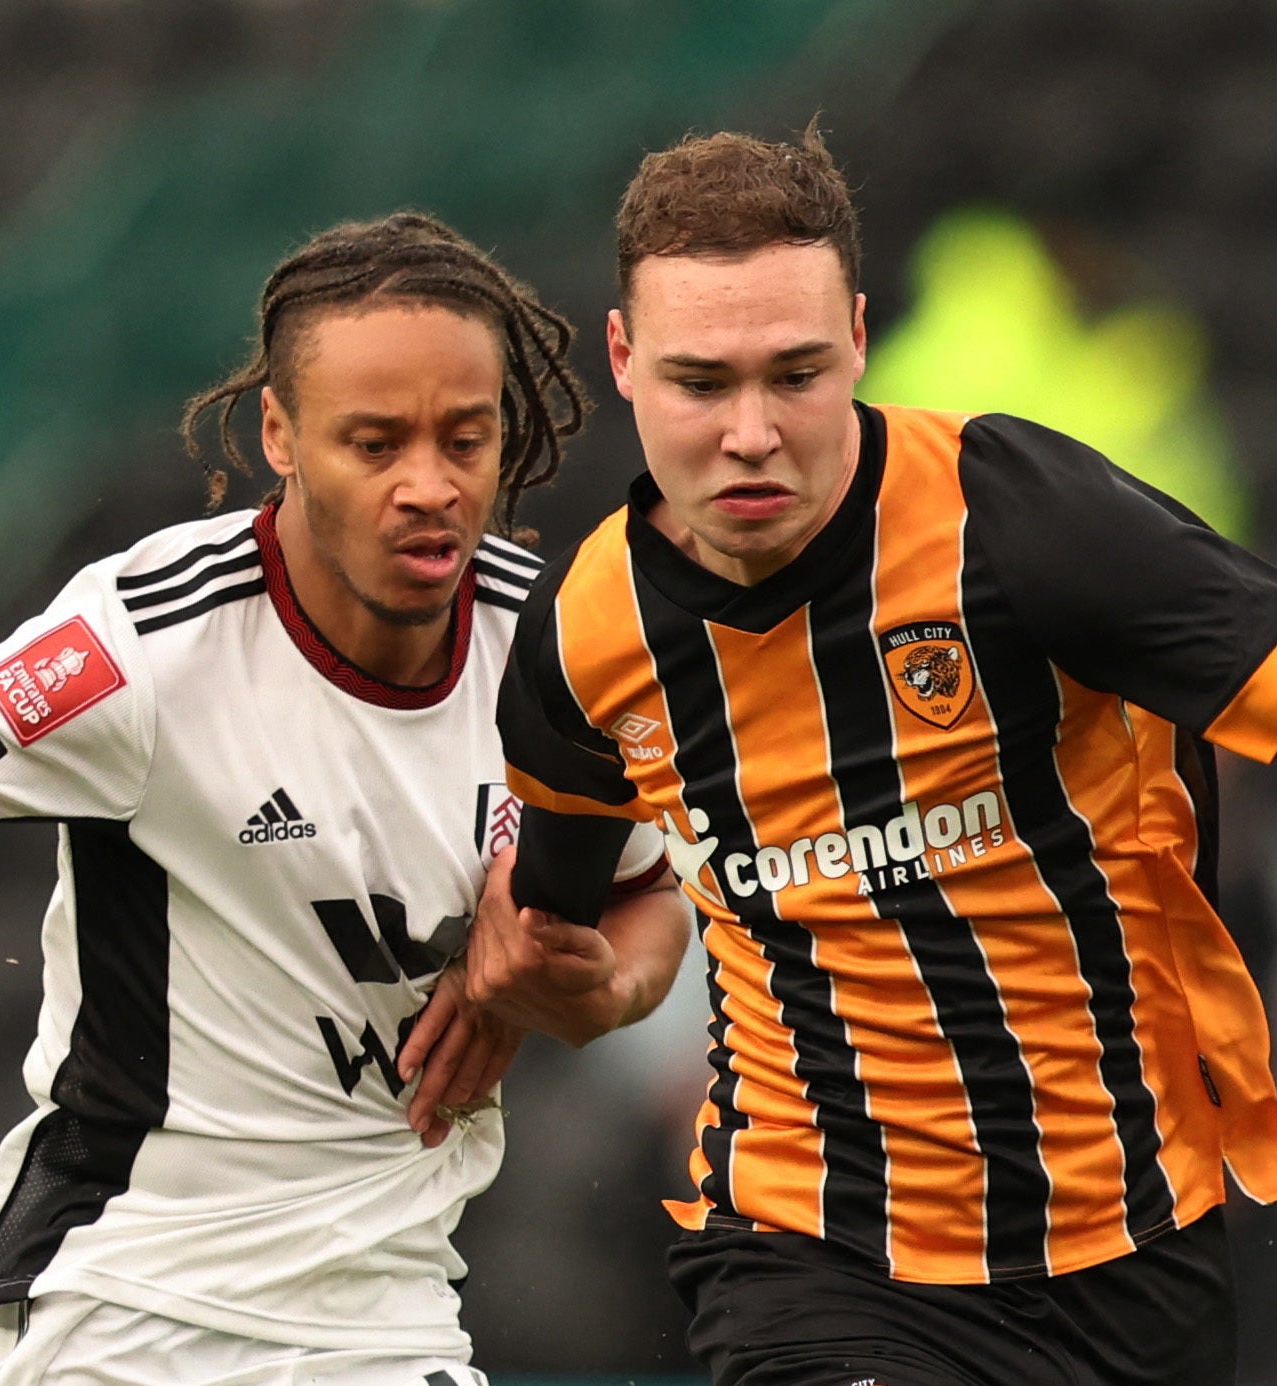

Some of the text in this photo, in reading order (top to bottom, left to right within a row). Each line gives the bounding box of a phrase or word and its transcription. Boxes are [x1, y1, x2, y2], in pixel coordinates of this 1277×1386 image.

[889, 626, 952, 647] HULL CITY
[8, 688, 40, 725] CUP
[9, 660, 52, 718] Emirates
[239, 820, 317, 845] adidas
[724, 790, 1003, 898] corendon
[857, 828, 1005, 896] AIRLINES
